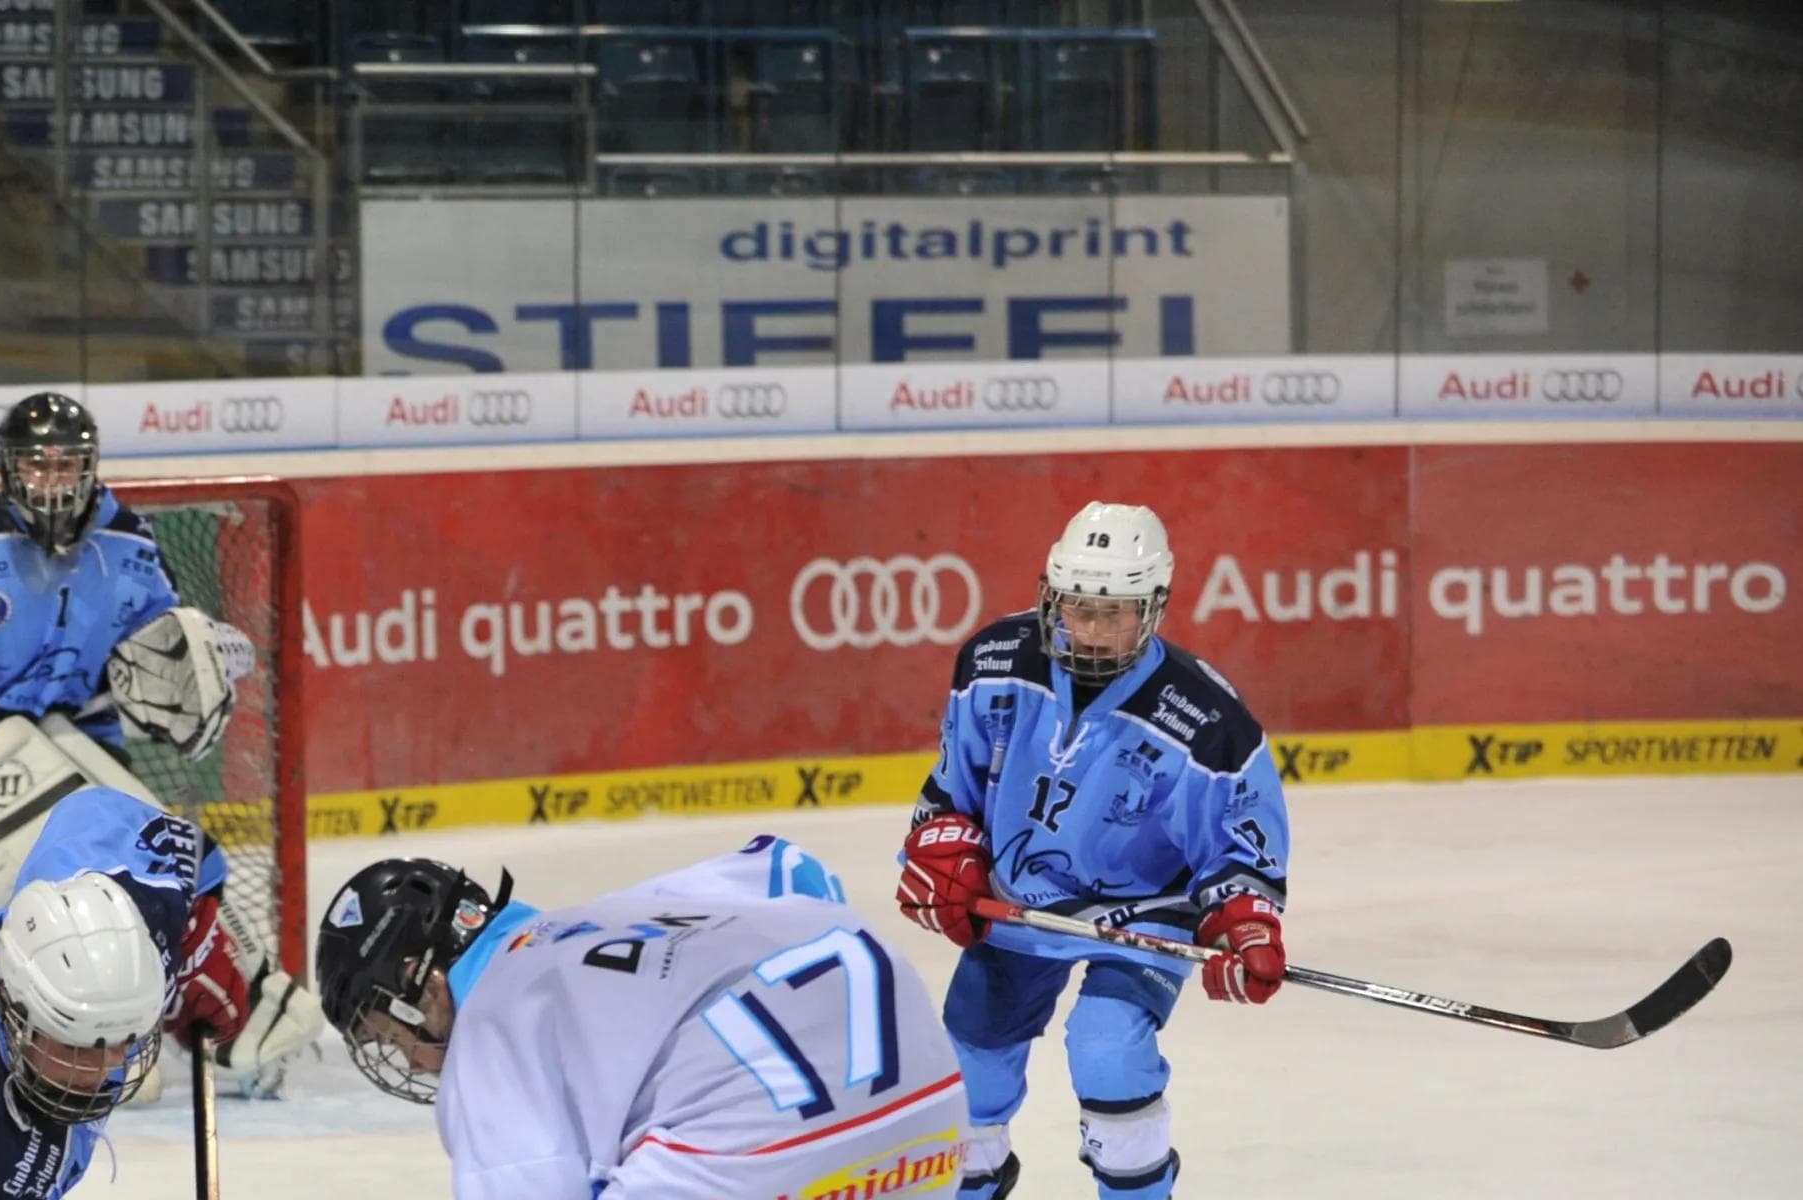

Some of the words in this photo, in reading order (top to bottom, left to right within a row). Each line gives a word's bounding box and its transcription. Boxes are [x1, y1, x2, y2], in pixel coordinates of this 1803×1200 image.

[721, 220, 1195, 270] digitalprint
[889, 379, 975, 412] Audi
[1163, 374, 1251, 403] Audi
[1437, 371, 1531, 401] Audi
[1691, 369, 1786, 400] Audi
[140, 401, 213, 434] Audi
[387, 393, 459, 427] Audi
[628, 386, 709, 419] Audi
[1192, 550, 1399, 623] Audi
[1429, 553, 1787, 635] quattro
[460, 584, 754, 677] quattro
[1563, 733, 1779, 767] SPORTWETTEN
[1028, 773, 1077, 833] 12
[700, 925, 899, 1121] 17
